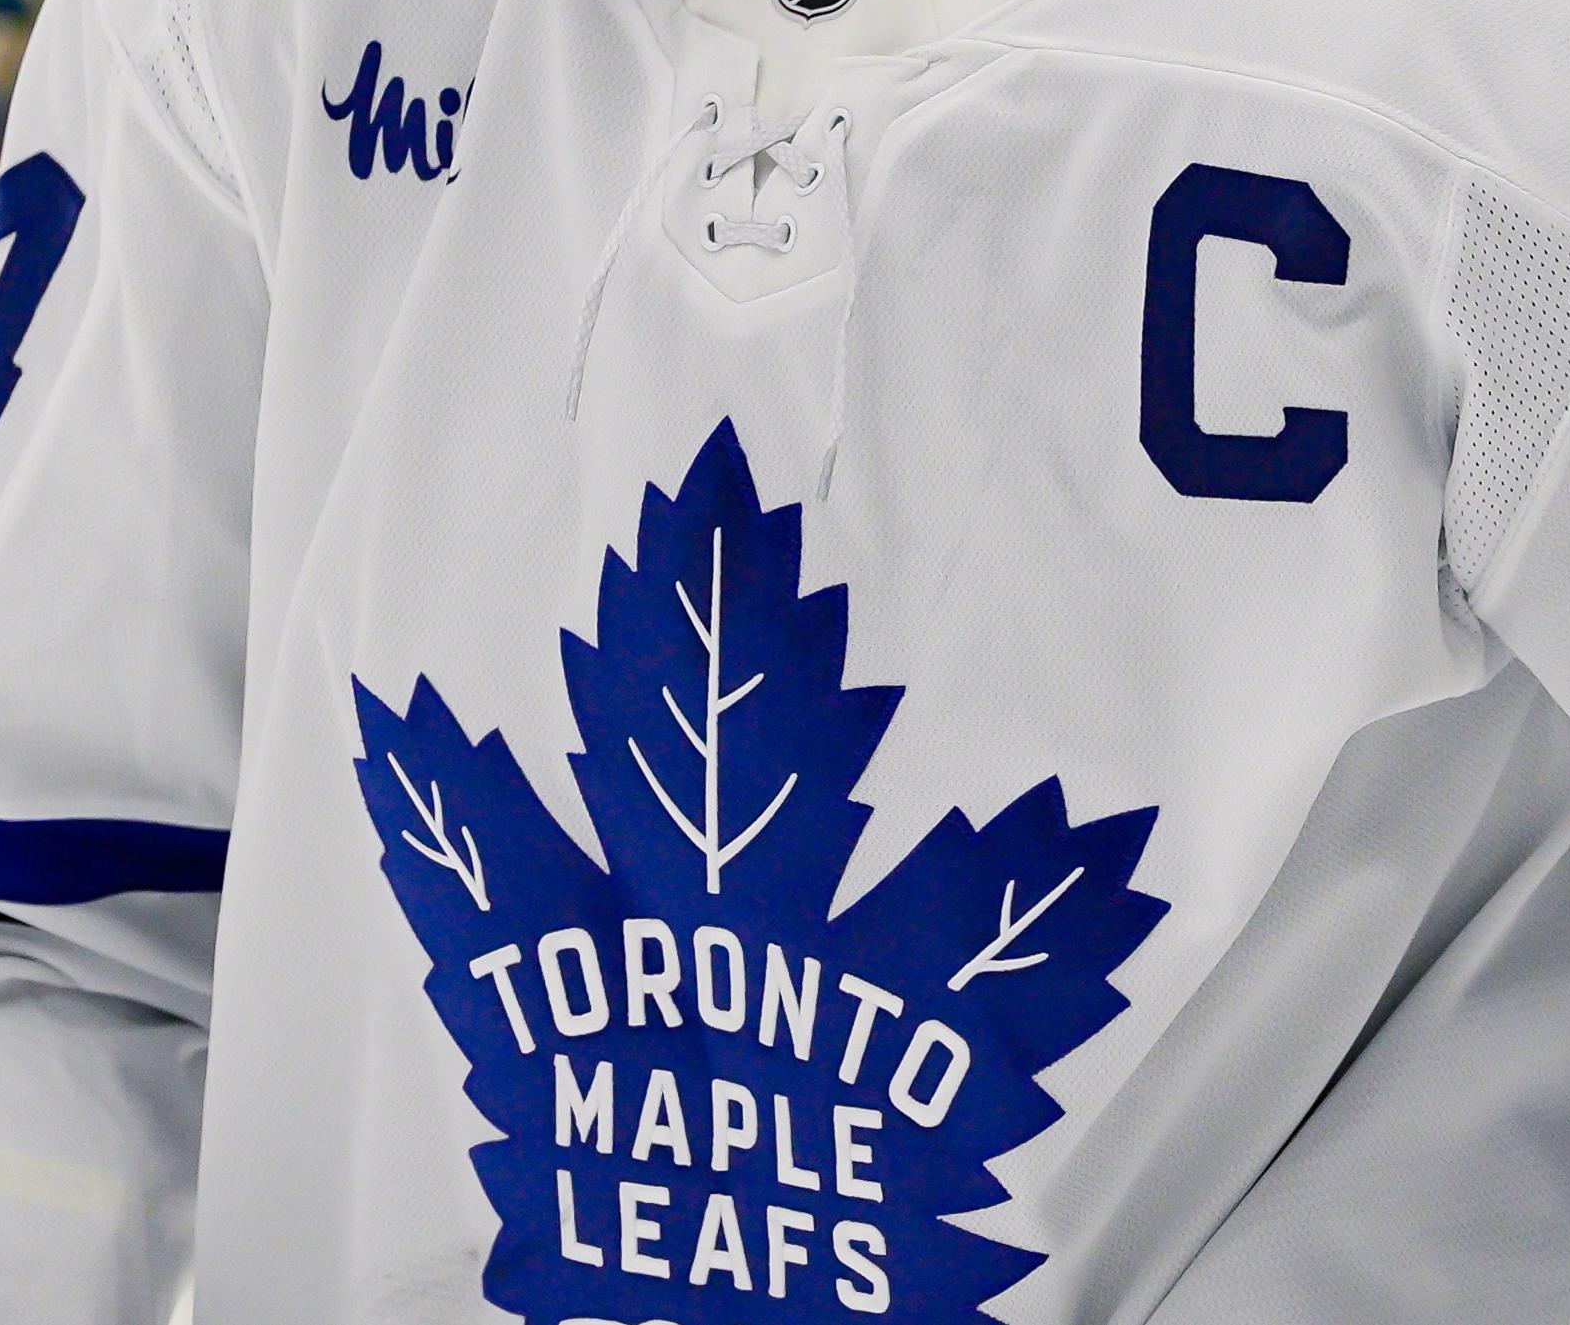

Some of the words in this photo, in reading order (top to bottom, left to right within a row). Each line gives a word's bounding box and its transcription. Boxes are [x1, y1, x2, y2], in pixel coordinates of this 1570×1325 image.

[321, 39, 476, 186] Mi
[1140, 162, 1351, 504] C
[469, 918, 971, 1128] TORONTO
[553, 1054, 885, 1203] MAPLE
[558, 1170, 890, 1314] LEAFS
